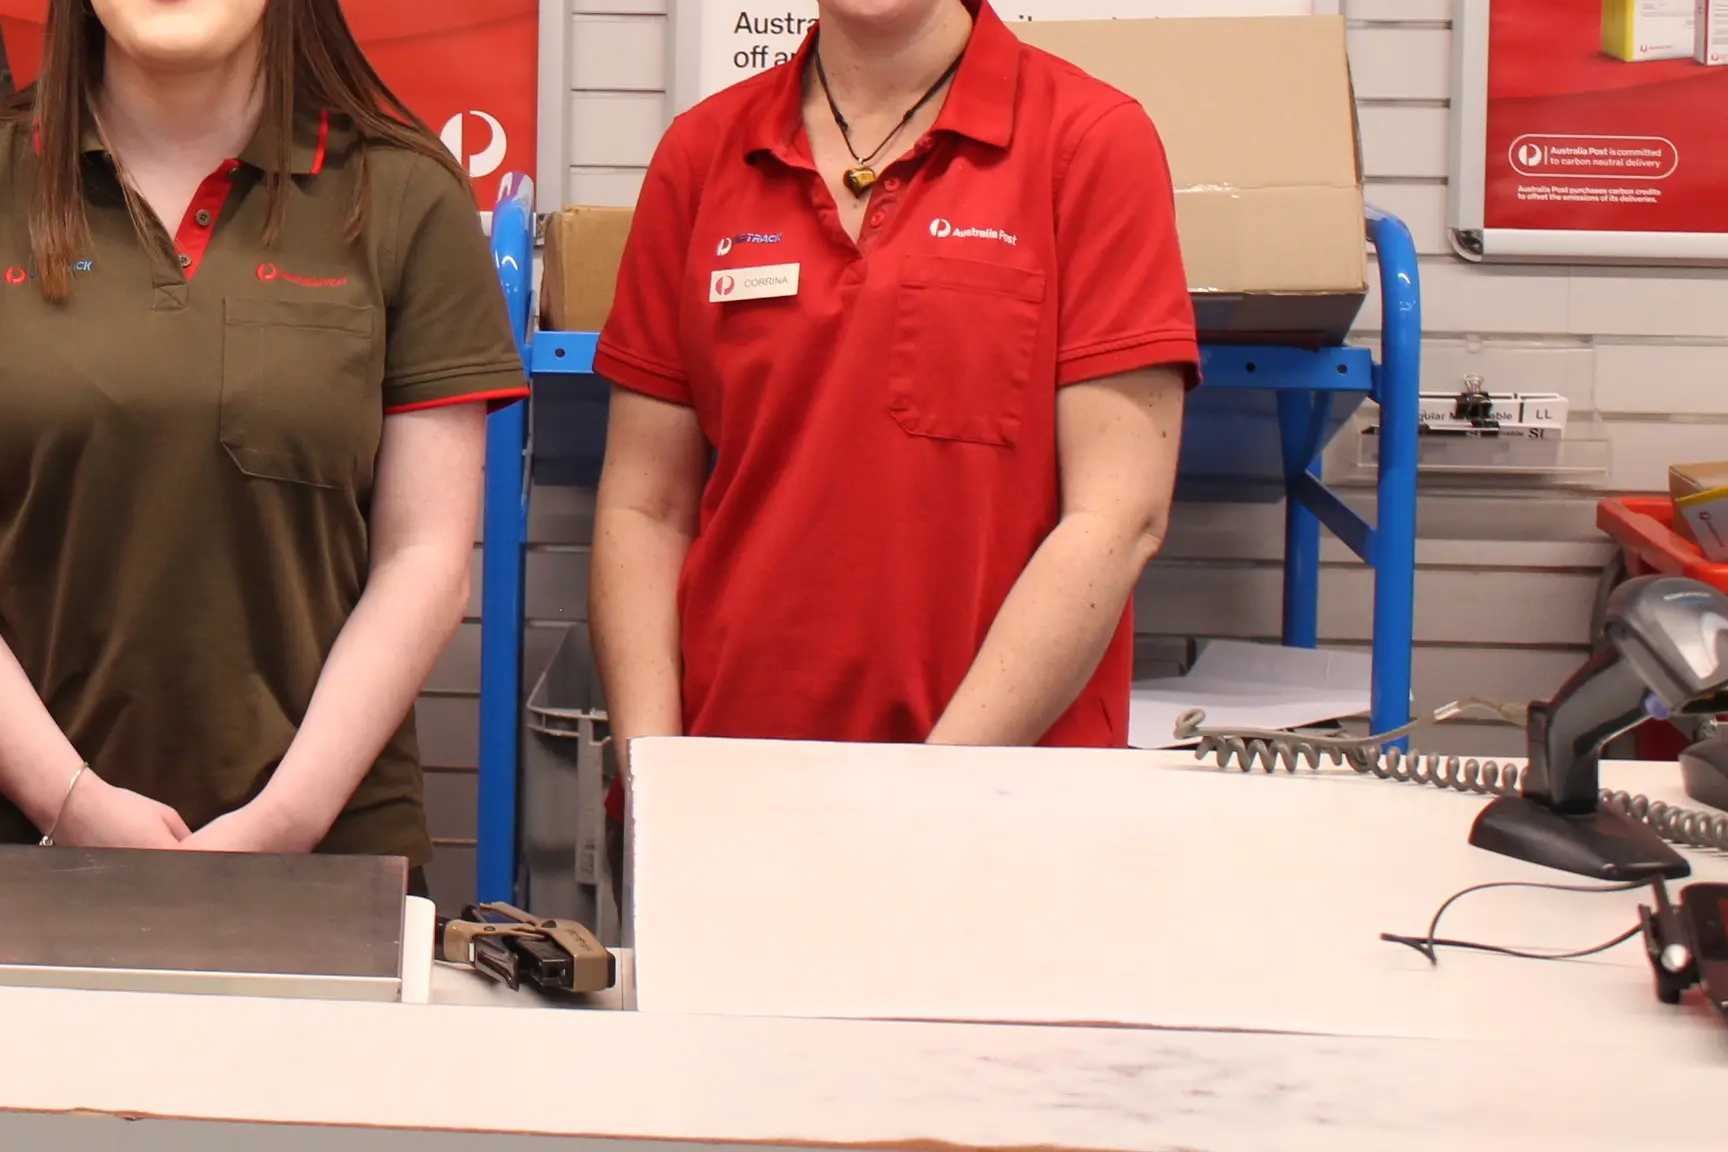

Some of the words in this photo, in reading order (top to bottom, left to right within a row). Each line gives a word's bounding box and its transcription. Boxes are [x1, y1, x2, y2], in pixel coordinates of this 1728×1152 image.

[733, 45, 769, 69] off
[1550, 147, 1588, 156] Australia
[1589, 147, 1608, 156] Post
[1609, 148, 1615, 156] is
[1616, 148, 1662, 157] committed
[1561, 158, 1591, 166] carbon
[1592, 157, 1623, 166] neutral
[1625, 158, 1661, 168] delivery
[953, 227, 998, 239] Australia
[998, 229, 1017, 246] Post
[744, 276, 788, 288] CORRINA
